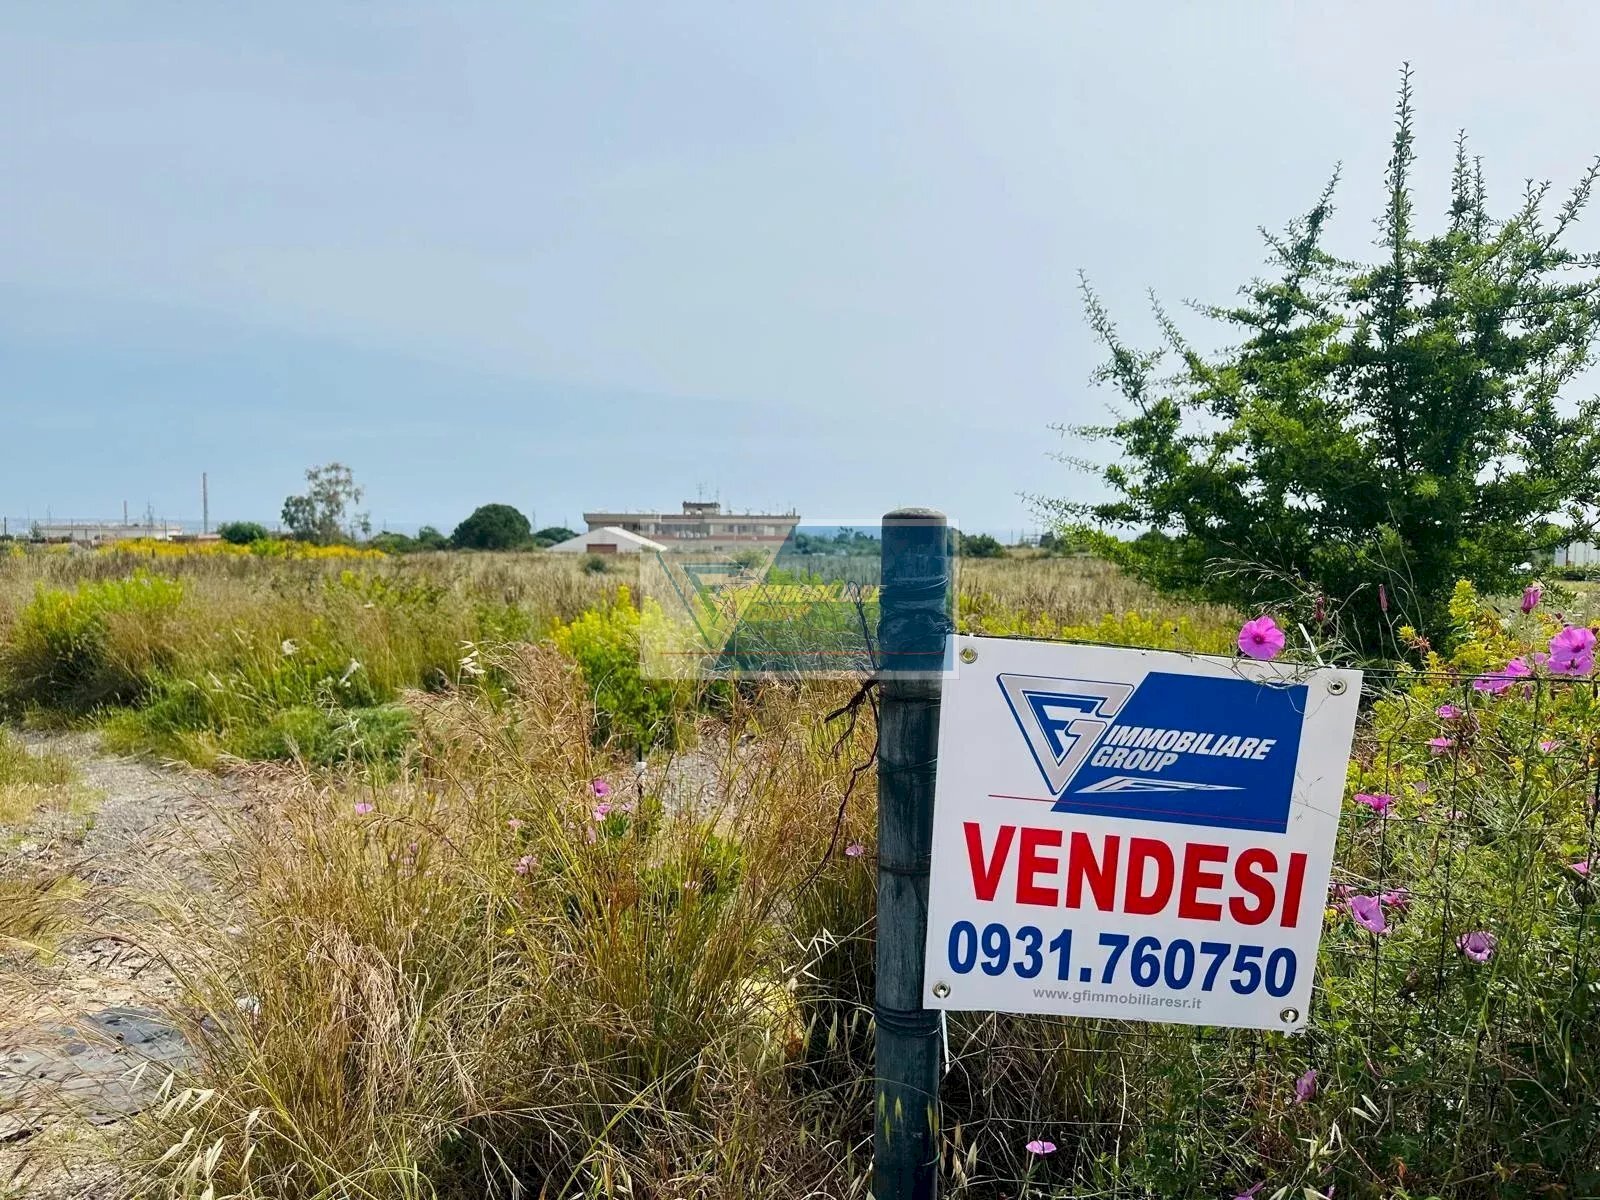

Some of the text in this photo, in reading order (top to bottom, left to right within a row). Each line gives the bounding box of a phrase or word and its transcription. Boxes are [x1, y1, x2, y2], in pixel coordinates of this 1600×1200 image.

[1103, 725, 1277, 760] IMMOBILIARE
[1091, 749, 1179, 772] GROUP
[963, 821, 1307, 928] VENDESI
[947, 920, 1297, 997] 0931.760750
[1033, 987, 1202, 1010] www.gfimmobiliaresr.it
